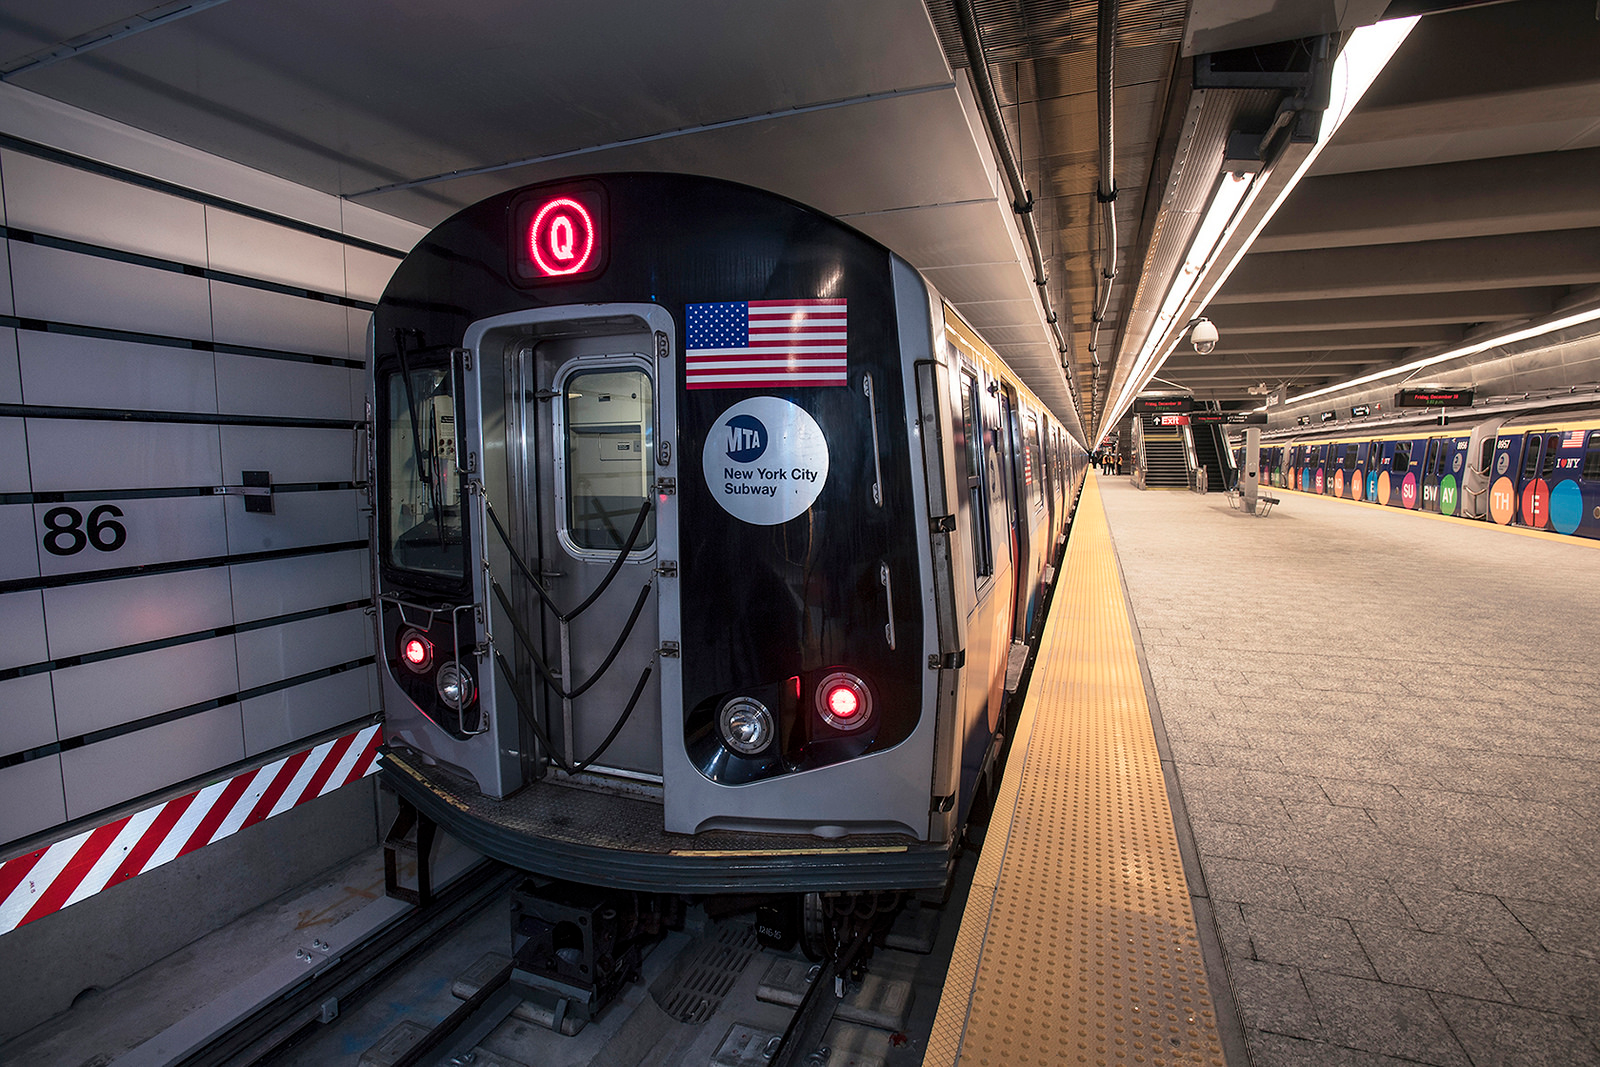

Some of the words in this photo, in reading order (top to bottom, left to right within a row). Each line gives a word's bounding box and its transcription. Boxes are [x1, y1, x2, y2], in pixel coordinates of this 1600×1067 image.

[551, 216, 574, 260] Q
[1161, 416, 1179, 425] Exit
[725, 425, 761, 453] MTA
[724, 468, 753, 479] New
[757, 468, 787, 480] York
[791, 468, 818, 482] City
[724, 483, 777, 497] Subway
[1403, 483, 1414, 499] SU
[1442, 487, 1455, 504] AY
[1494, 492, 1510, 511] TH
[1531, 494, 1540, 514] E
[43, 504, 127, 556] 86
